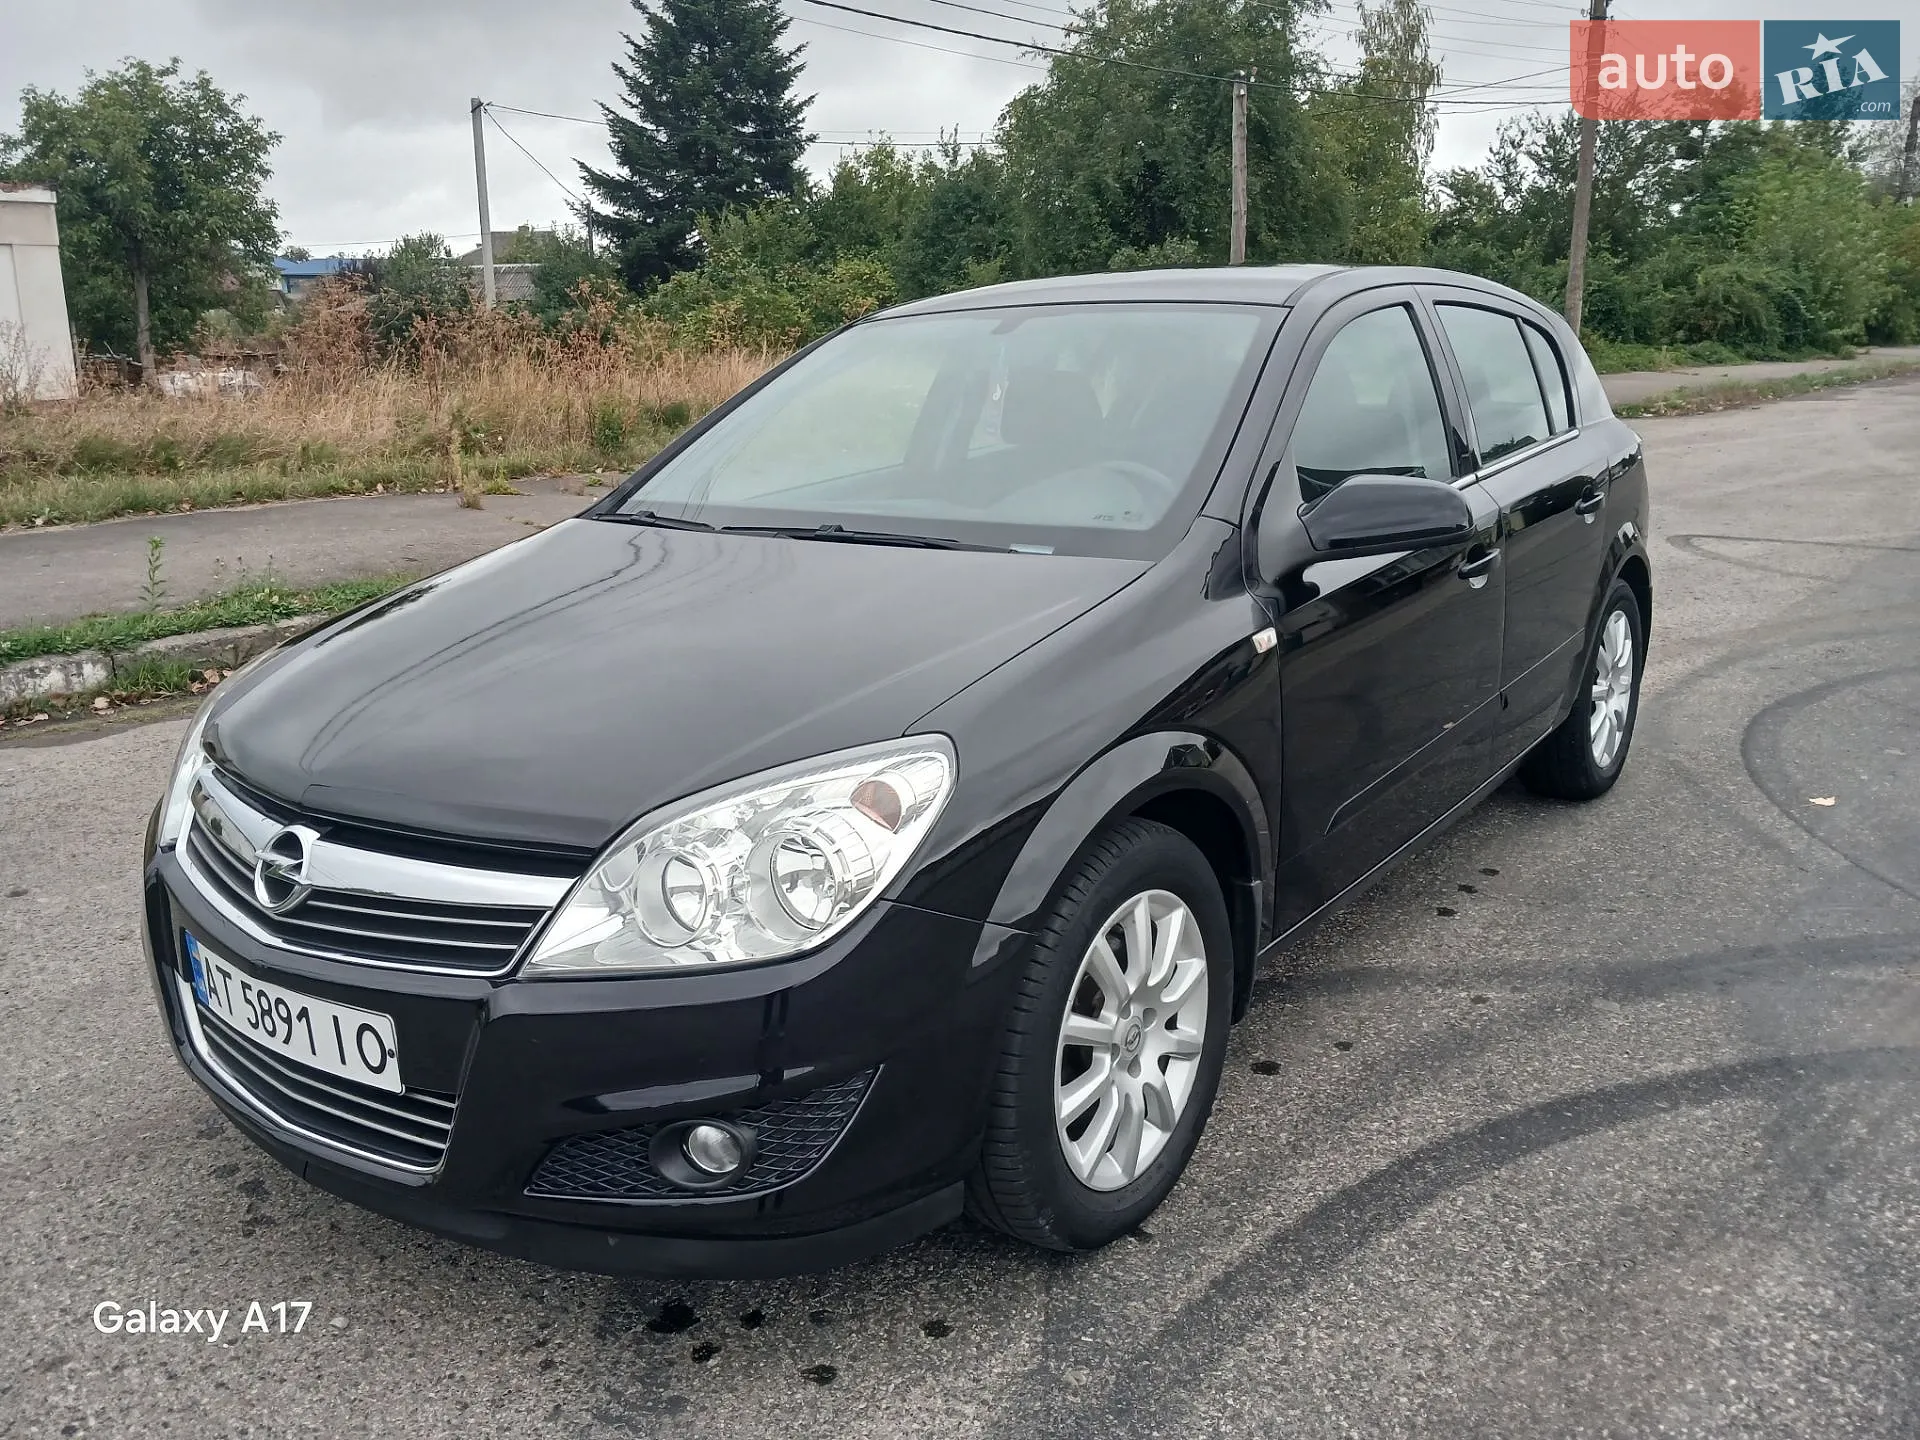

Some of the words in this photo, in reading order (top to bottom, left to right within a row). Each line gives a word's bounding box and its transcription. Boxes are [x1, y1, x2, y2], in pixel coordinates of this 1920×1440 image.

[203, 956, 232, 1017] AT
[240, 979, 317, 1057] 5891
[332, 1014, 388, 1075] IO
